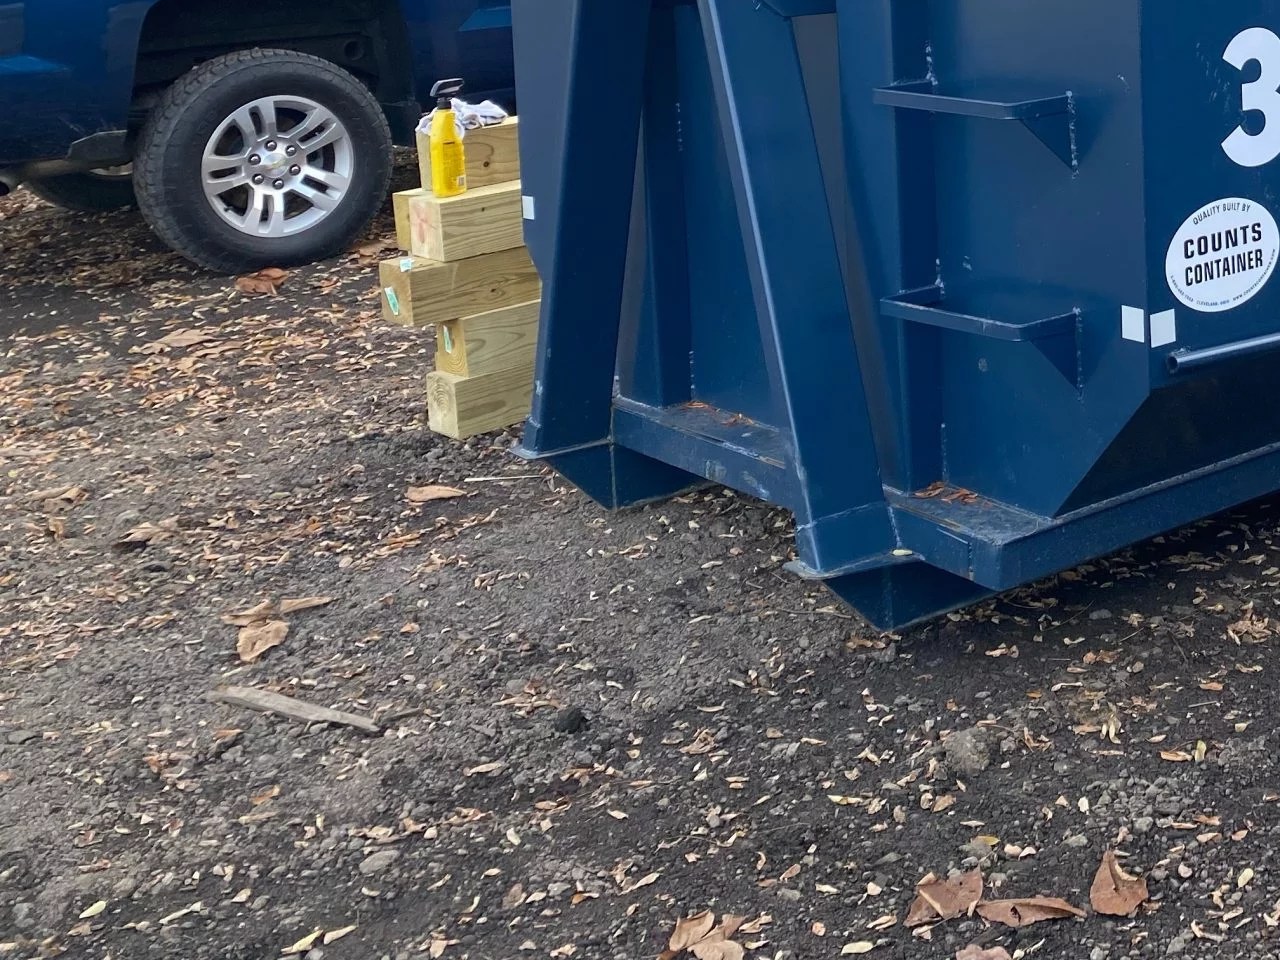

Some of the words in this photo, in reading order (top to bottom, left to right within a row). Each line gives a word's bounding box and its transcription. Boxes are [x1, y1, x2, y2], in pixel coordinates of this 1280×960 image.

[1193, 204, 1220, 225] QUALITY
[1222, 202, 1241, 212] BUILT
[1241, 203, 1251, 213] BY
[1183, 222, 1262, 260] COUNTS
[1184, 248, 1263, 287] CONTAINER
